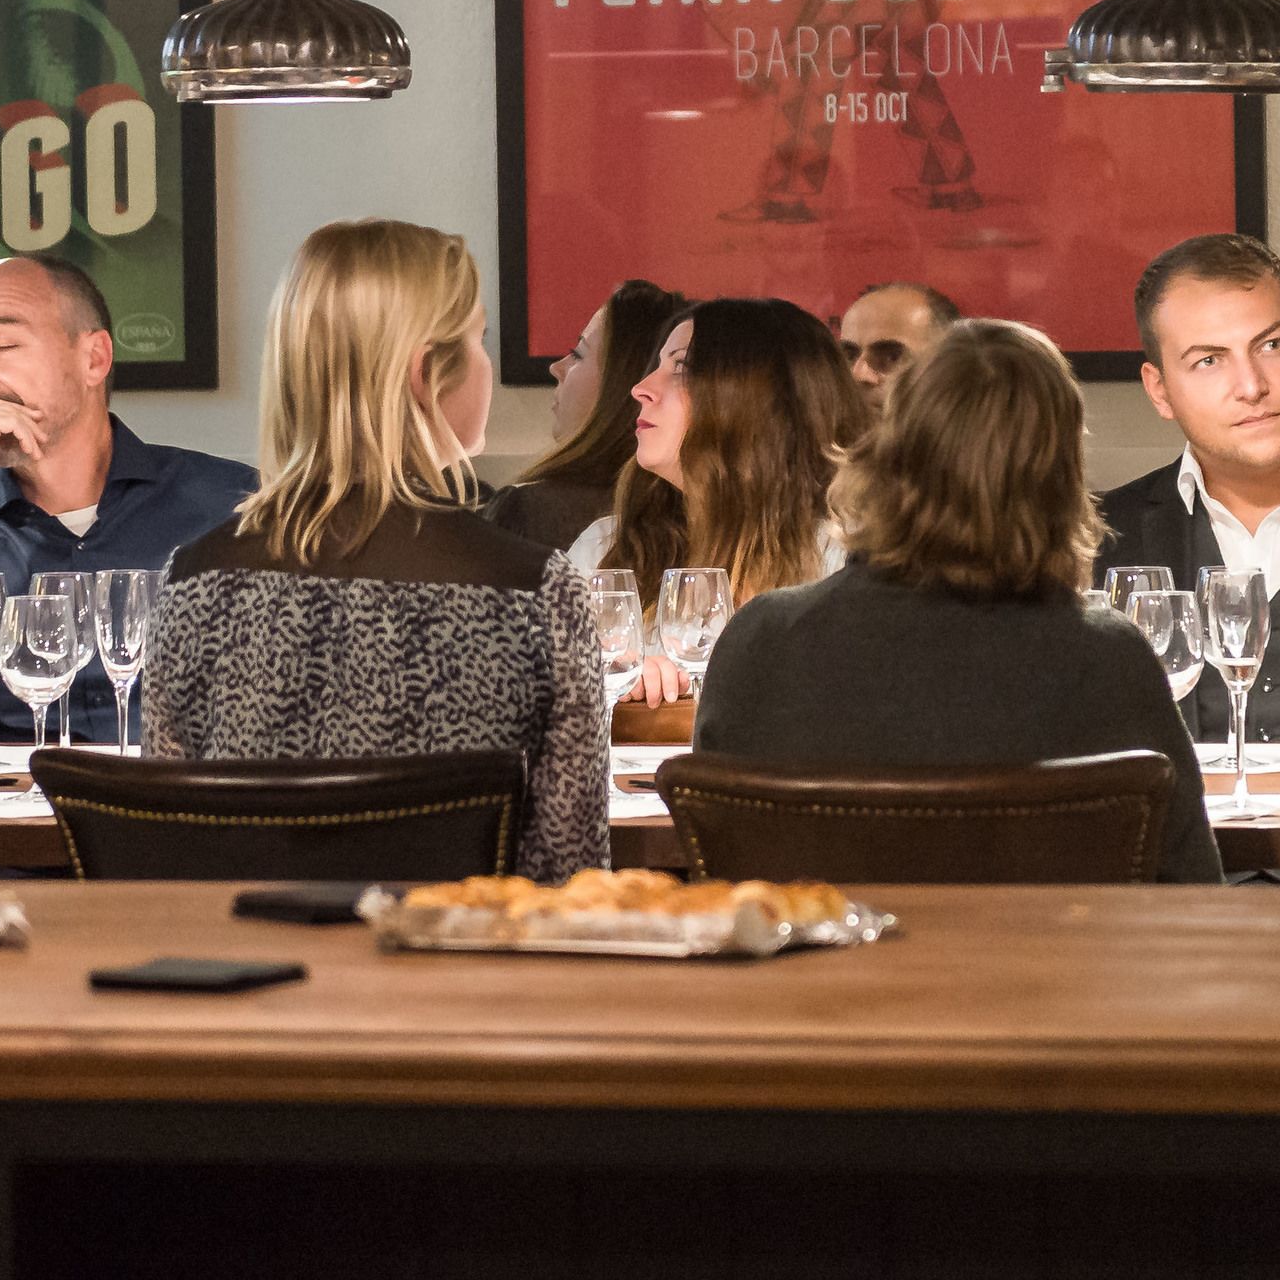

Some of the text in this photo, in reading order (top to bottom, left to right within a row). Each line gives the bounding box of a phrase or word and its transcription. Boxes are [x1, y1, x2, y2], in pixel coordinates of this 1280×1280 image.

[735, 22, 1014, 80] BARCELONA
[825, 91, 910, 123] 8-15 OCT
